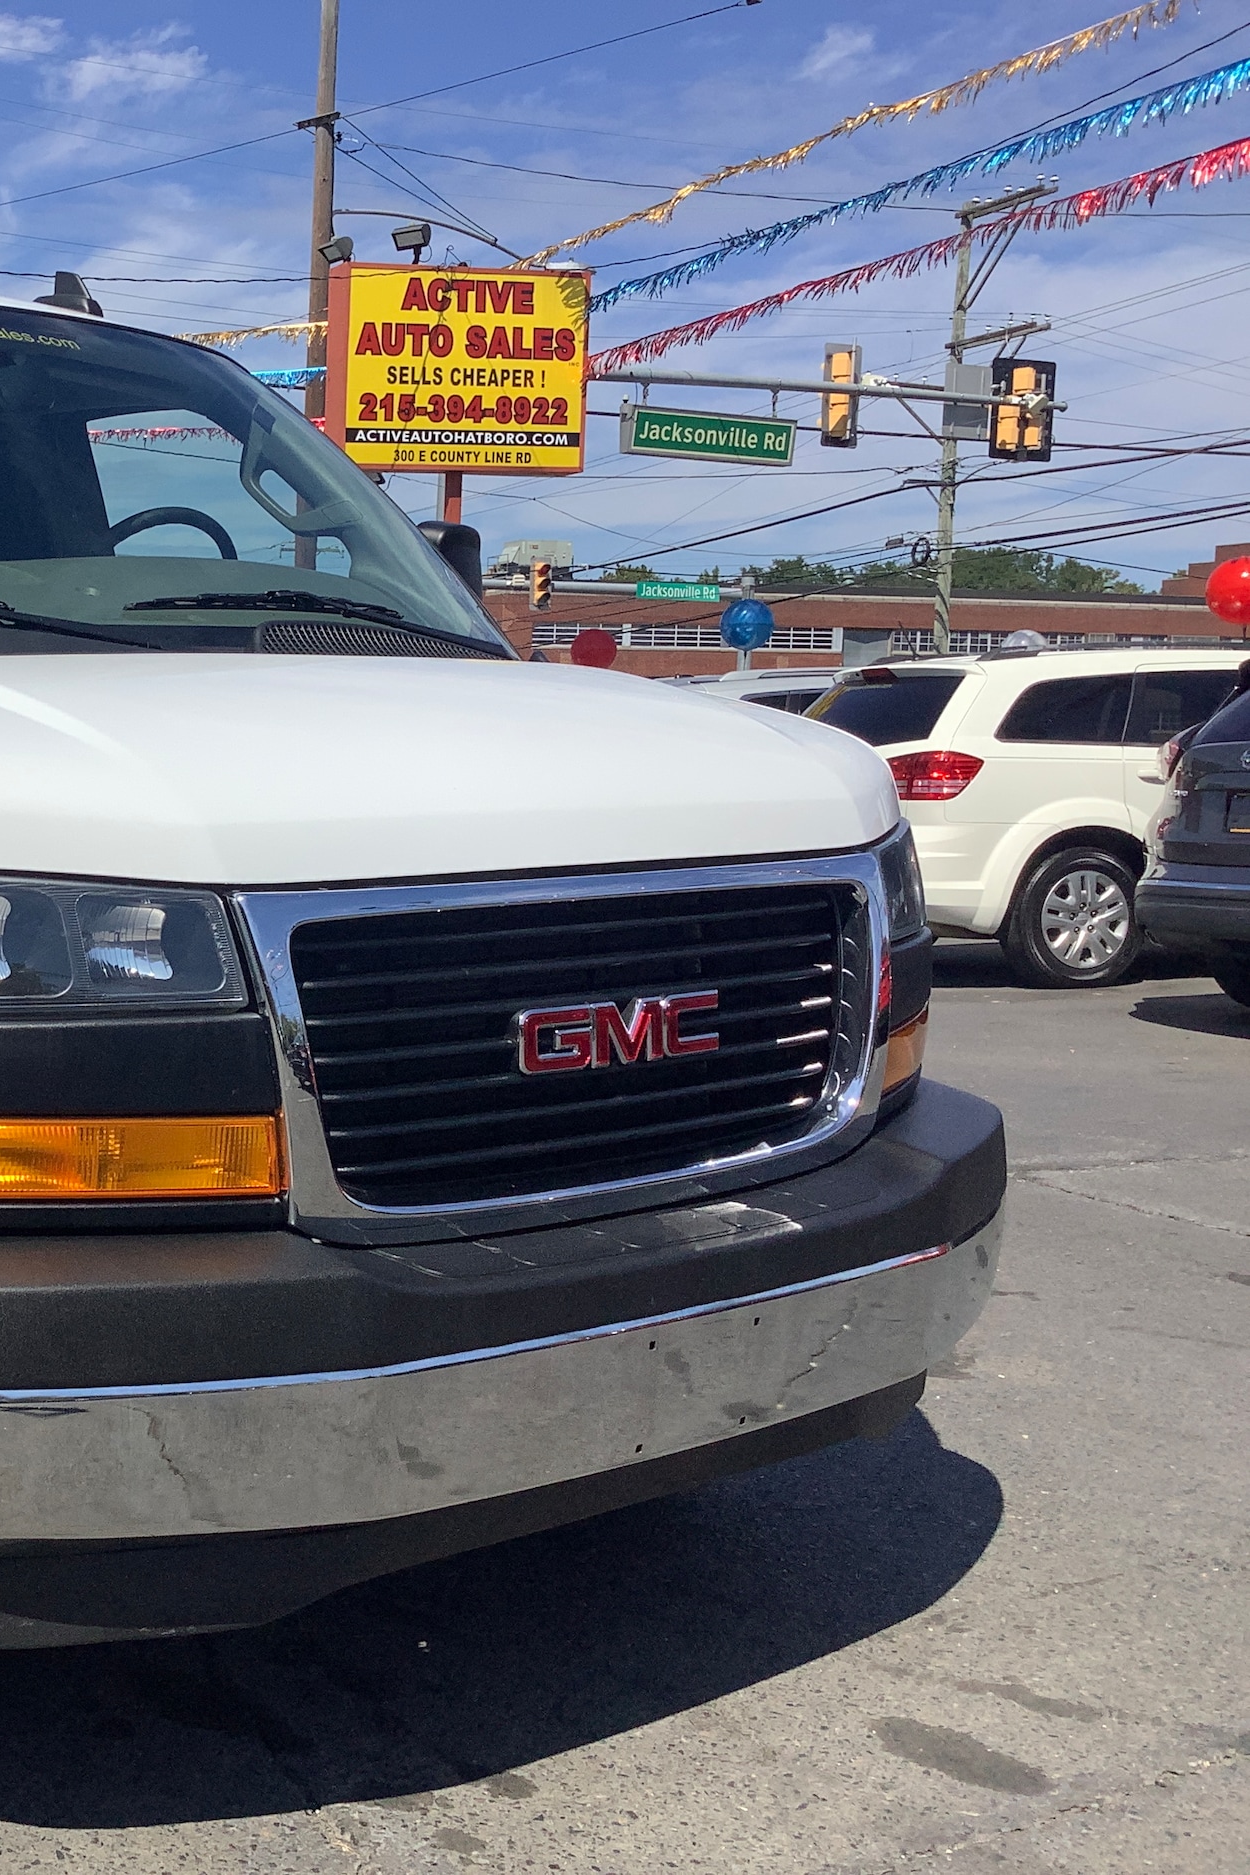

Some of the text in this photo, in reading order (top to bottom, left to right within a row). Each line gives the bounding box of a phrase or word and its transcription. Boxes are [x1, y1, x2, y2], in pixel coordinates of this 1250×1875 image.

[400, 277, 535, 315] ACTIVE
[355, 322, 576, 361] AUTO SALES
[387, 366, 443, 385] SELLS
[450, 369, 535, 388] CHEAPER
[358, 392, 569, 425] 215-394-8922
[355, 429, 569, 446] ACTIVEAUTOHATBORO.COM
[639, 420, 787, 452] Jacksonville Rd
[393, 449, 532, 464] 300 E COUNTY LINE RD
[640, 583, 716, 600] Jacksonville Rd
[518, 988, 720, 1076] GMC
